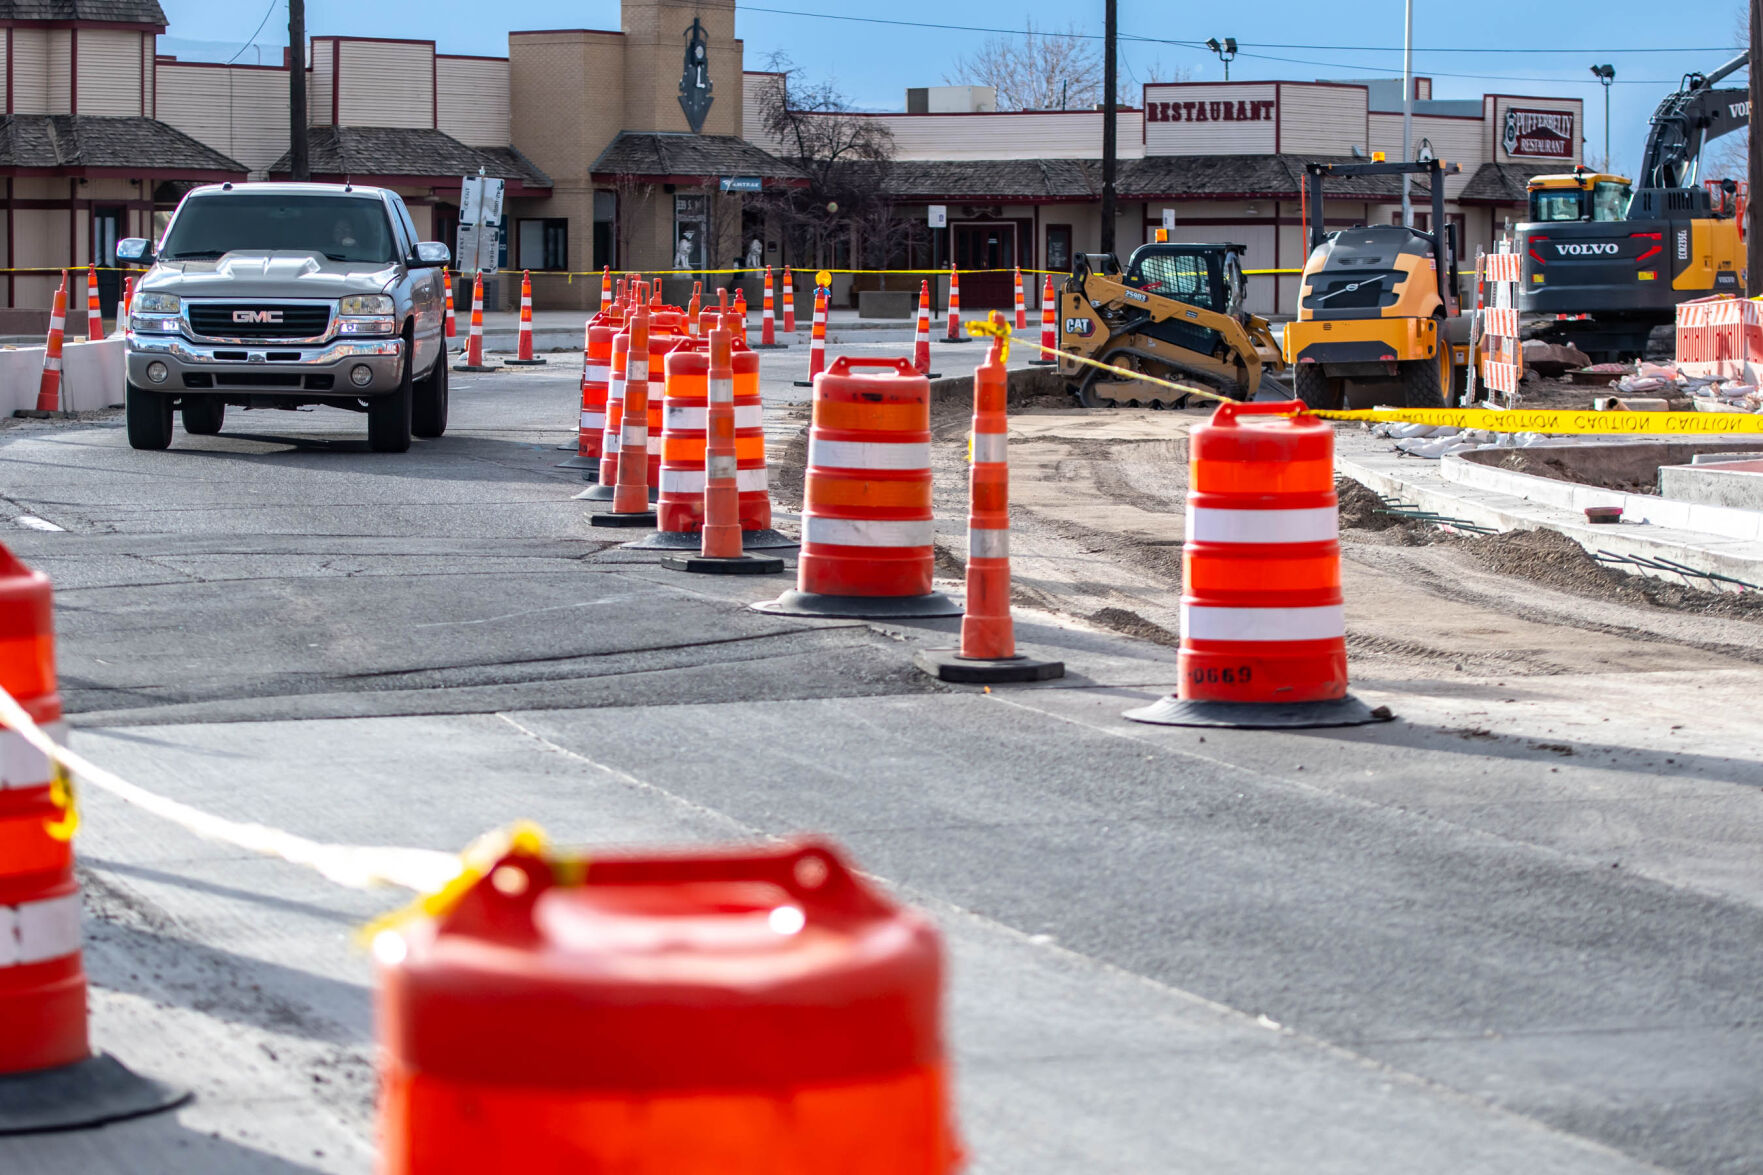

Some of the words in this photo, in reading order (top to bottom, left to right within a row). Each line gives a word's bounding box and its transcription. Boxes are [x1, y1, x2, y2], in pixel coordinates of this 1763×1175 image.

[1147, 100, 1275, 122] RESTAURANT
[1515, 112, 1573, 139] PUFFERBELLY
[1520, 138, 1565, 153] RESTAURANT
[1555, 243, 1619, 255] VOLVO
[232, 310, 284, 323] GMC
[1065, 318, 1089, 334] CAT
[1192, 665, 1252, 685] 0669
